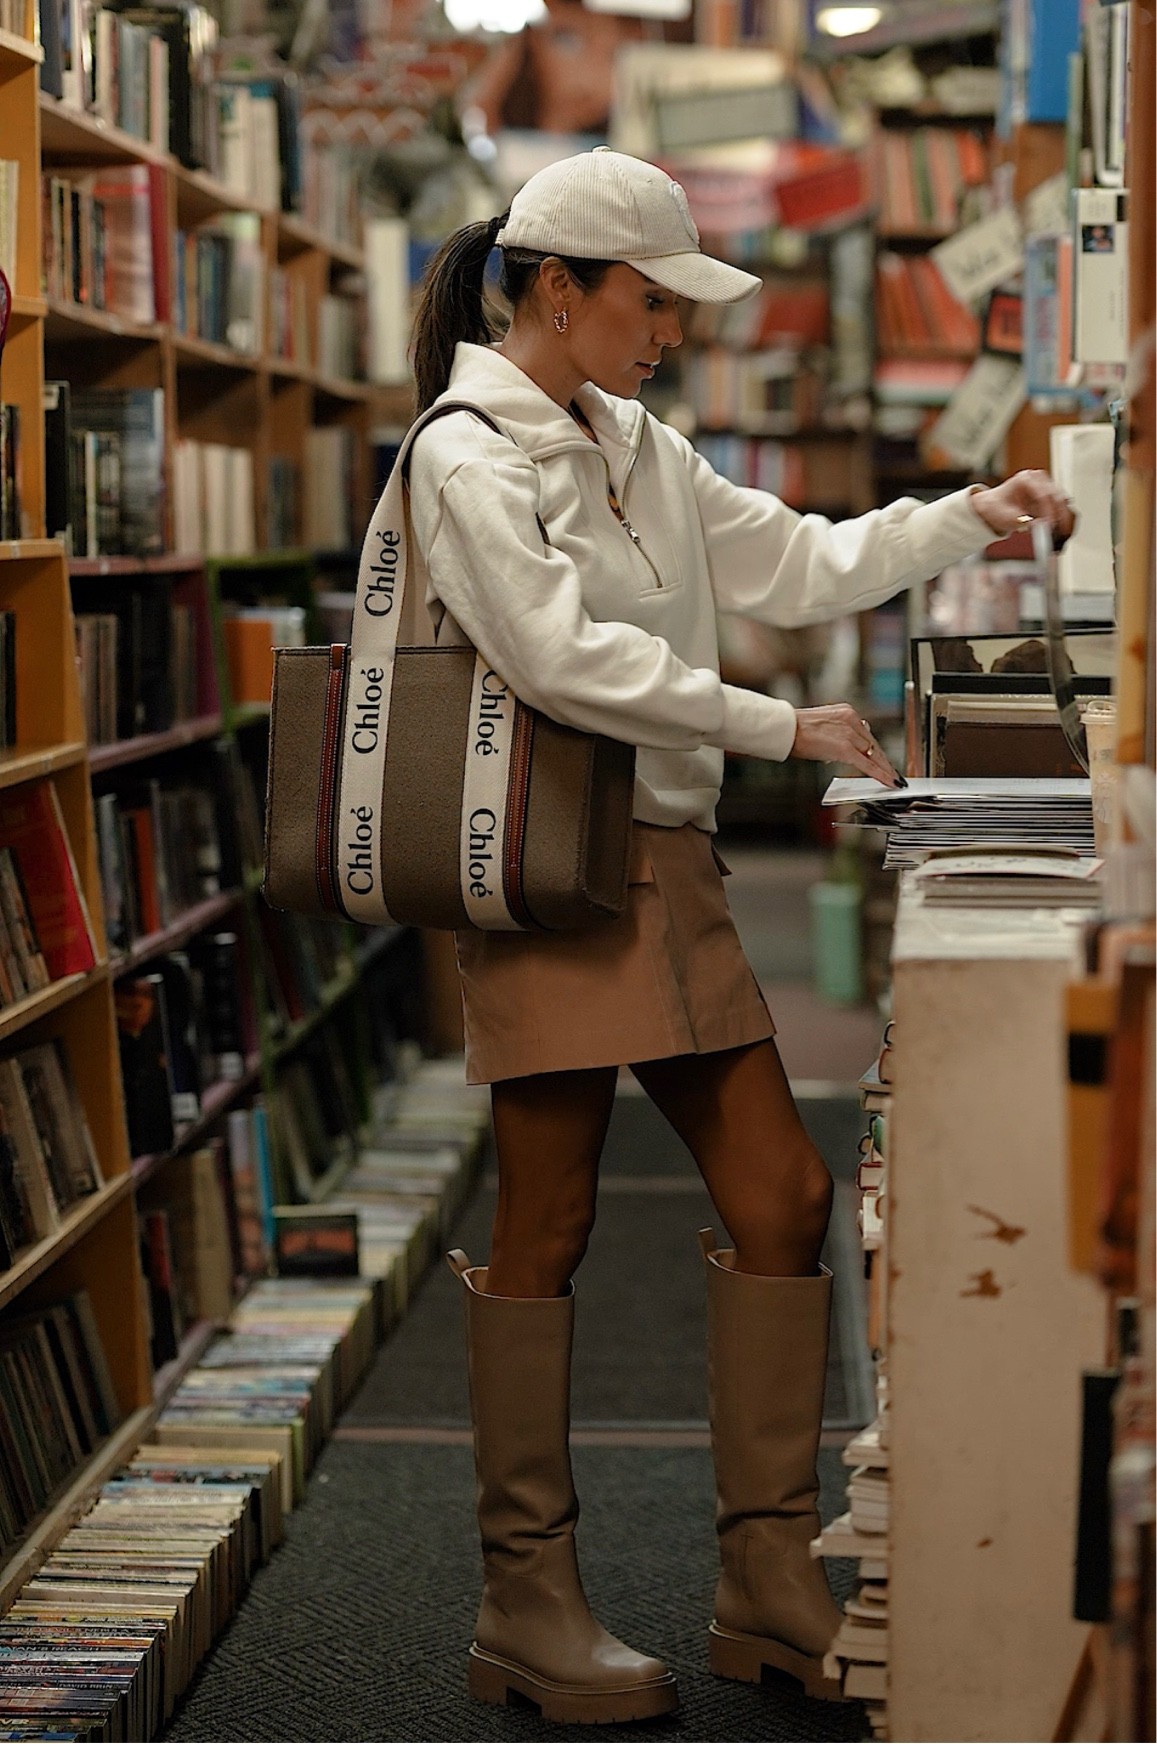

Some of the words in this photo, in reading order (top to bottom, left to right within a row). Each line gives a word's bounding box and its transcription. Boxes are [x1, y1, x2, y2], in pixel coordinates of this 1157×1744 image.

[363, 530, 401, 617] Chloé
[351, 667, 385, 755] Chloé
[475, 669, 509, 756] Chloé
[346, 806, 374, 896] Chloé
[468, 808, 497, 899] Chloé
